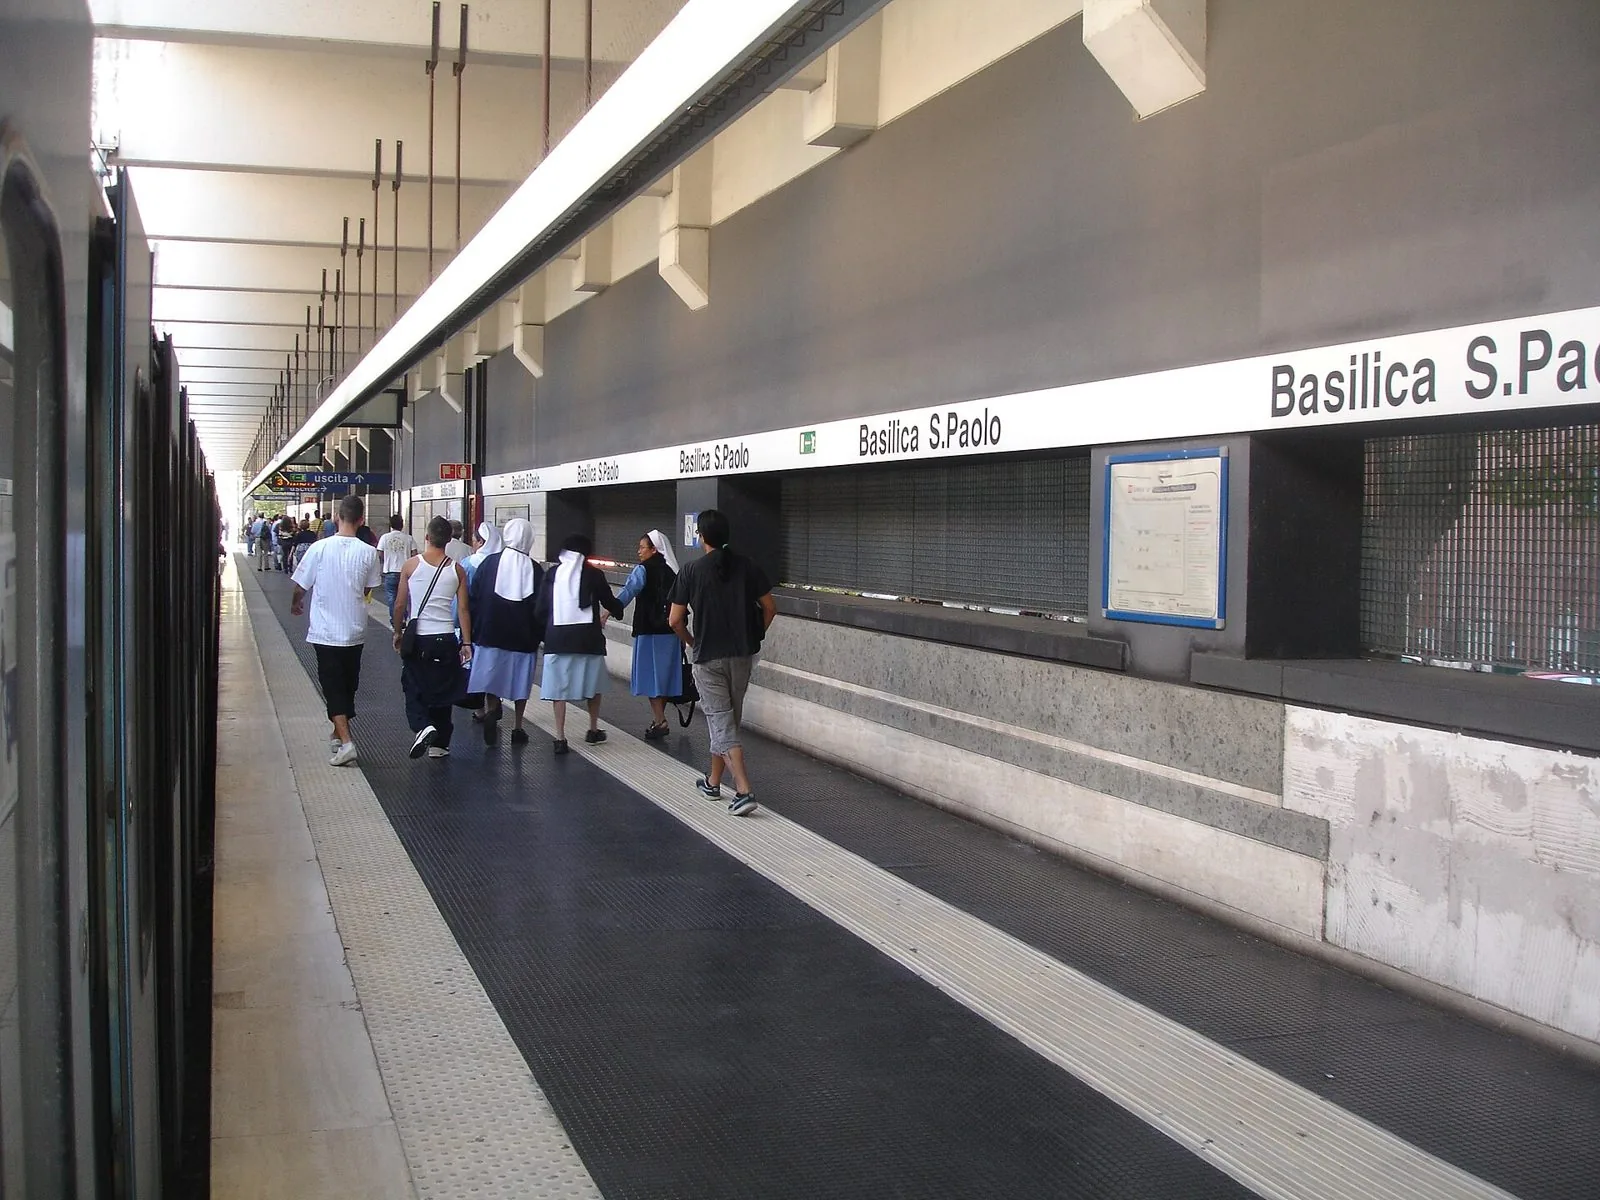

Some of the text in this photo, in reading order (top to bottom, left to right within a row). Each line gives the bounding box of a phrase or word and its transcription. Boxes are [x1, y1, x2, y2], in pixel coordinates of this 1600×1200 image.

[1271, 350, 1436, 418] Basilica
[859, 407, 1002, 457] Basilica S.Paolo
[577, 460, 620, 483] Basilica S.Paolo
[679, 442, 750, 474] Basilica S.Paolo
[314, 473, 349, 483] uscita
